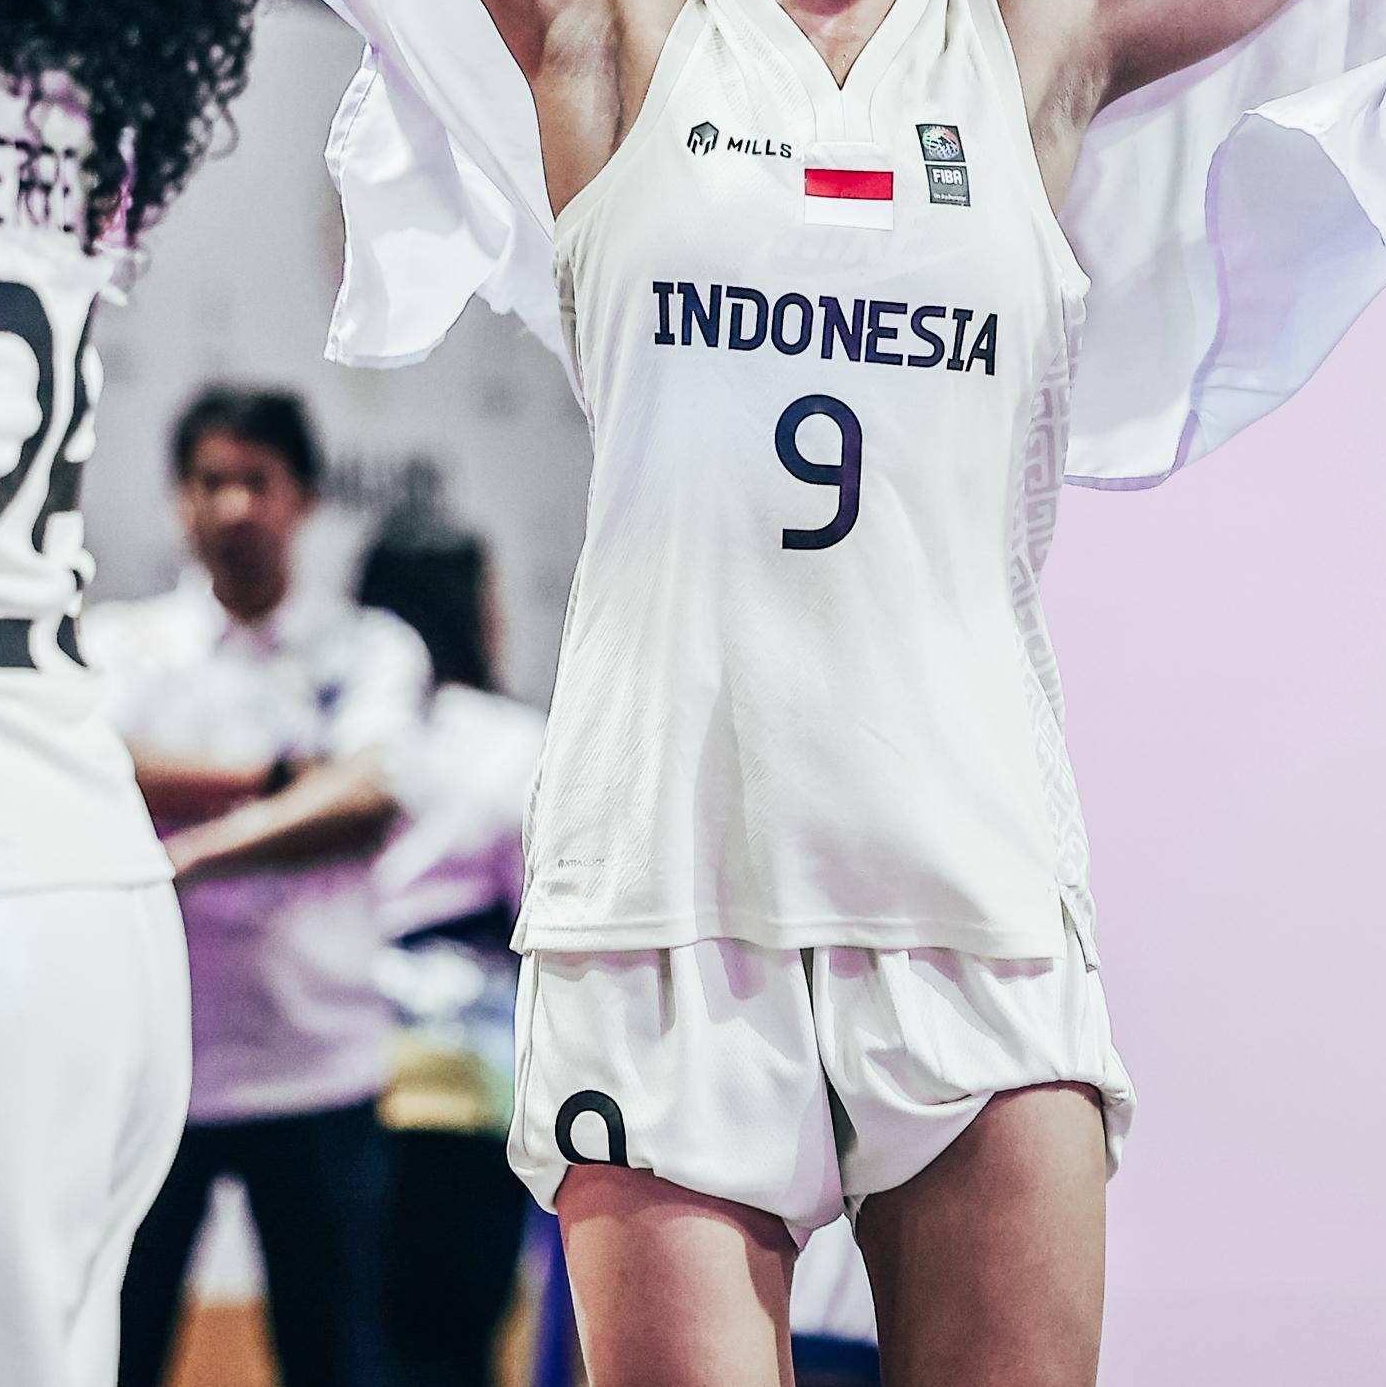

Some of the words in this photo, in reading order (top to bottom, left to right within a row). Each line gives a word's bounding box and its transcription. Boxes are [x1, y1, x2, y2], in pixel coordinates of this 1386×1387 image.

[726, 136, 792, 159] MILLS
[932, 168, 963, 185] FIBA
[653, 280, 998, 376] INDONESIA
[774, 394, 862, 550] 9
